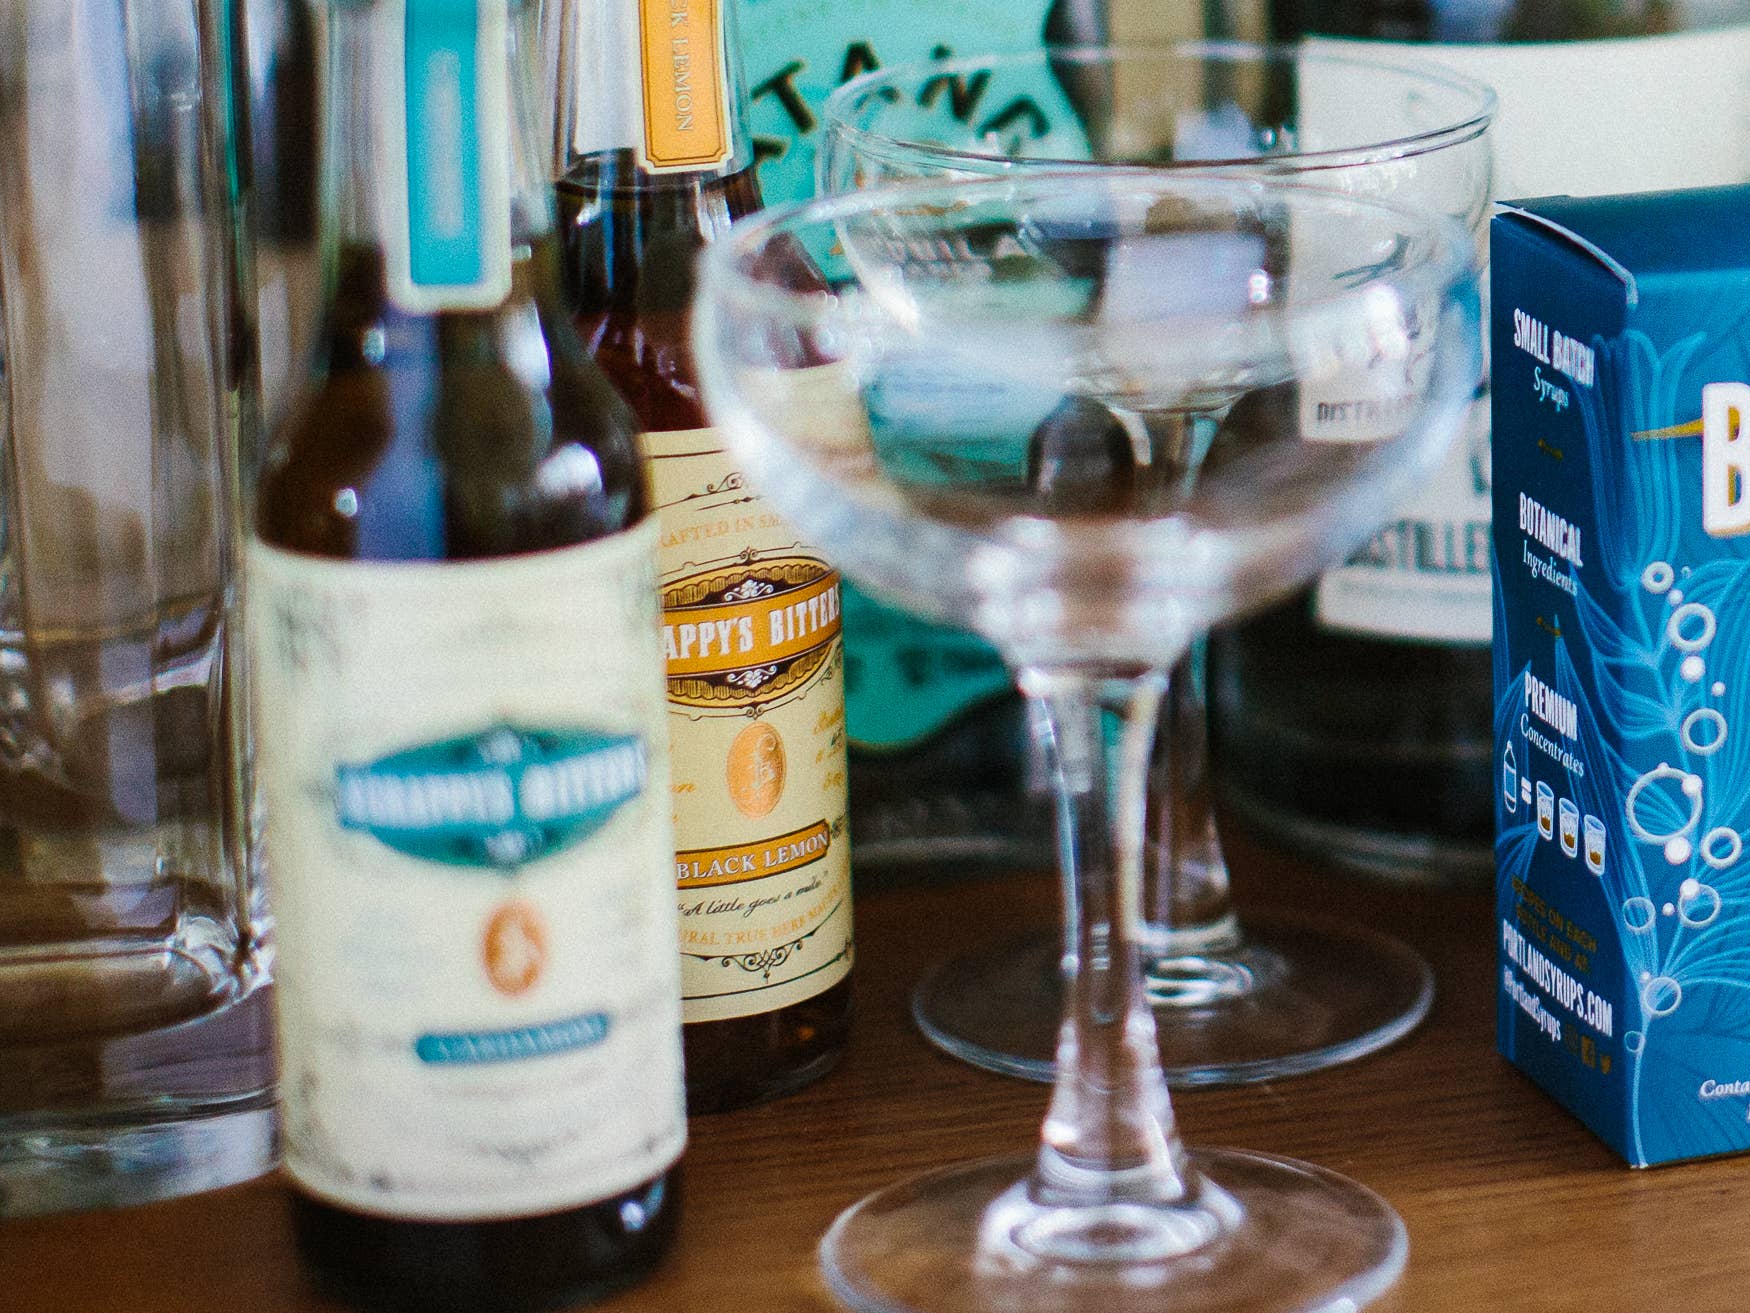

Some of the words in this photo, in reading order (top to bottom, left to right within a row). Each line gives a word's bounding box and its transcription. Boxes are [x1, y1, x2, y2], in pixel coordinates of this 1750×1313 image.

[672, 38, 695, 132] LEMON
[1513, 307, 1551, 365] SMALL
[1519, 491, 1584, 568] BOTANICAL
[1522, 539, 1578, 597] Ingredients
[1524, 670, 1578, 742] PREMIUM
[1520, 712, 1585, 778] Concentrates
[676, 854, 757, 881] BLACK
[763, 831, 829, 869] LEMON
[705, 897, 744, 915] little
[742, 893, 782, 918] goes
[1503, 918, 1613, 1038] PORTLANDSYRUPS.COM
